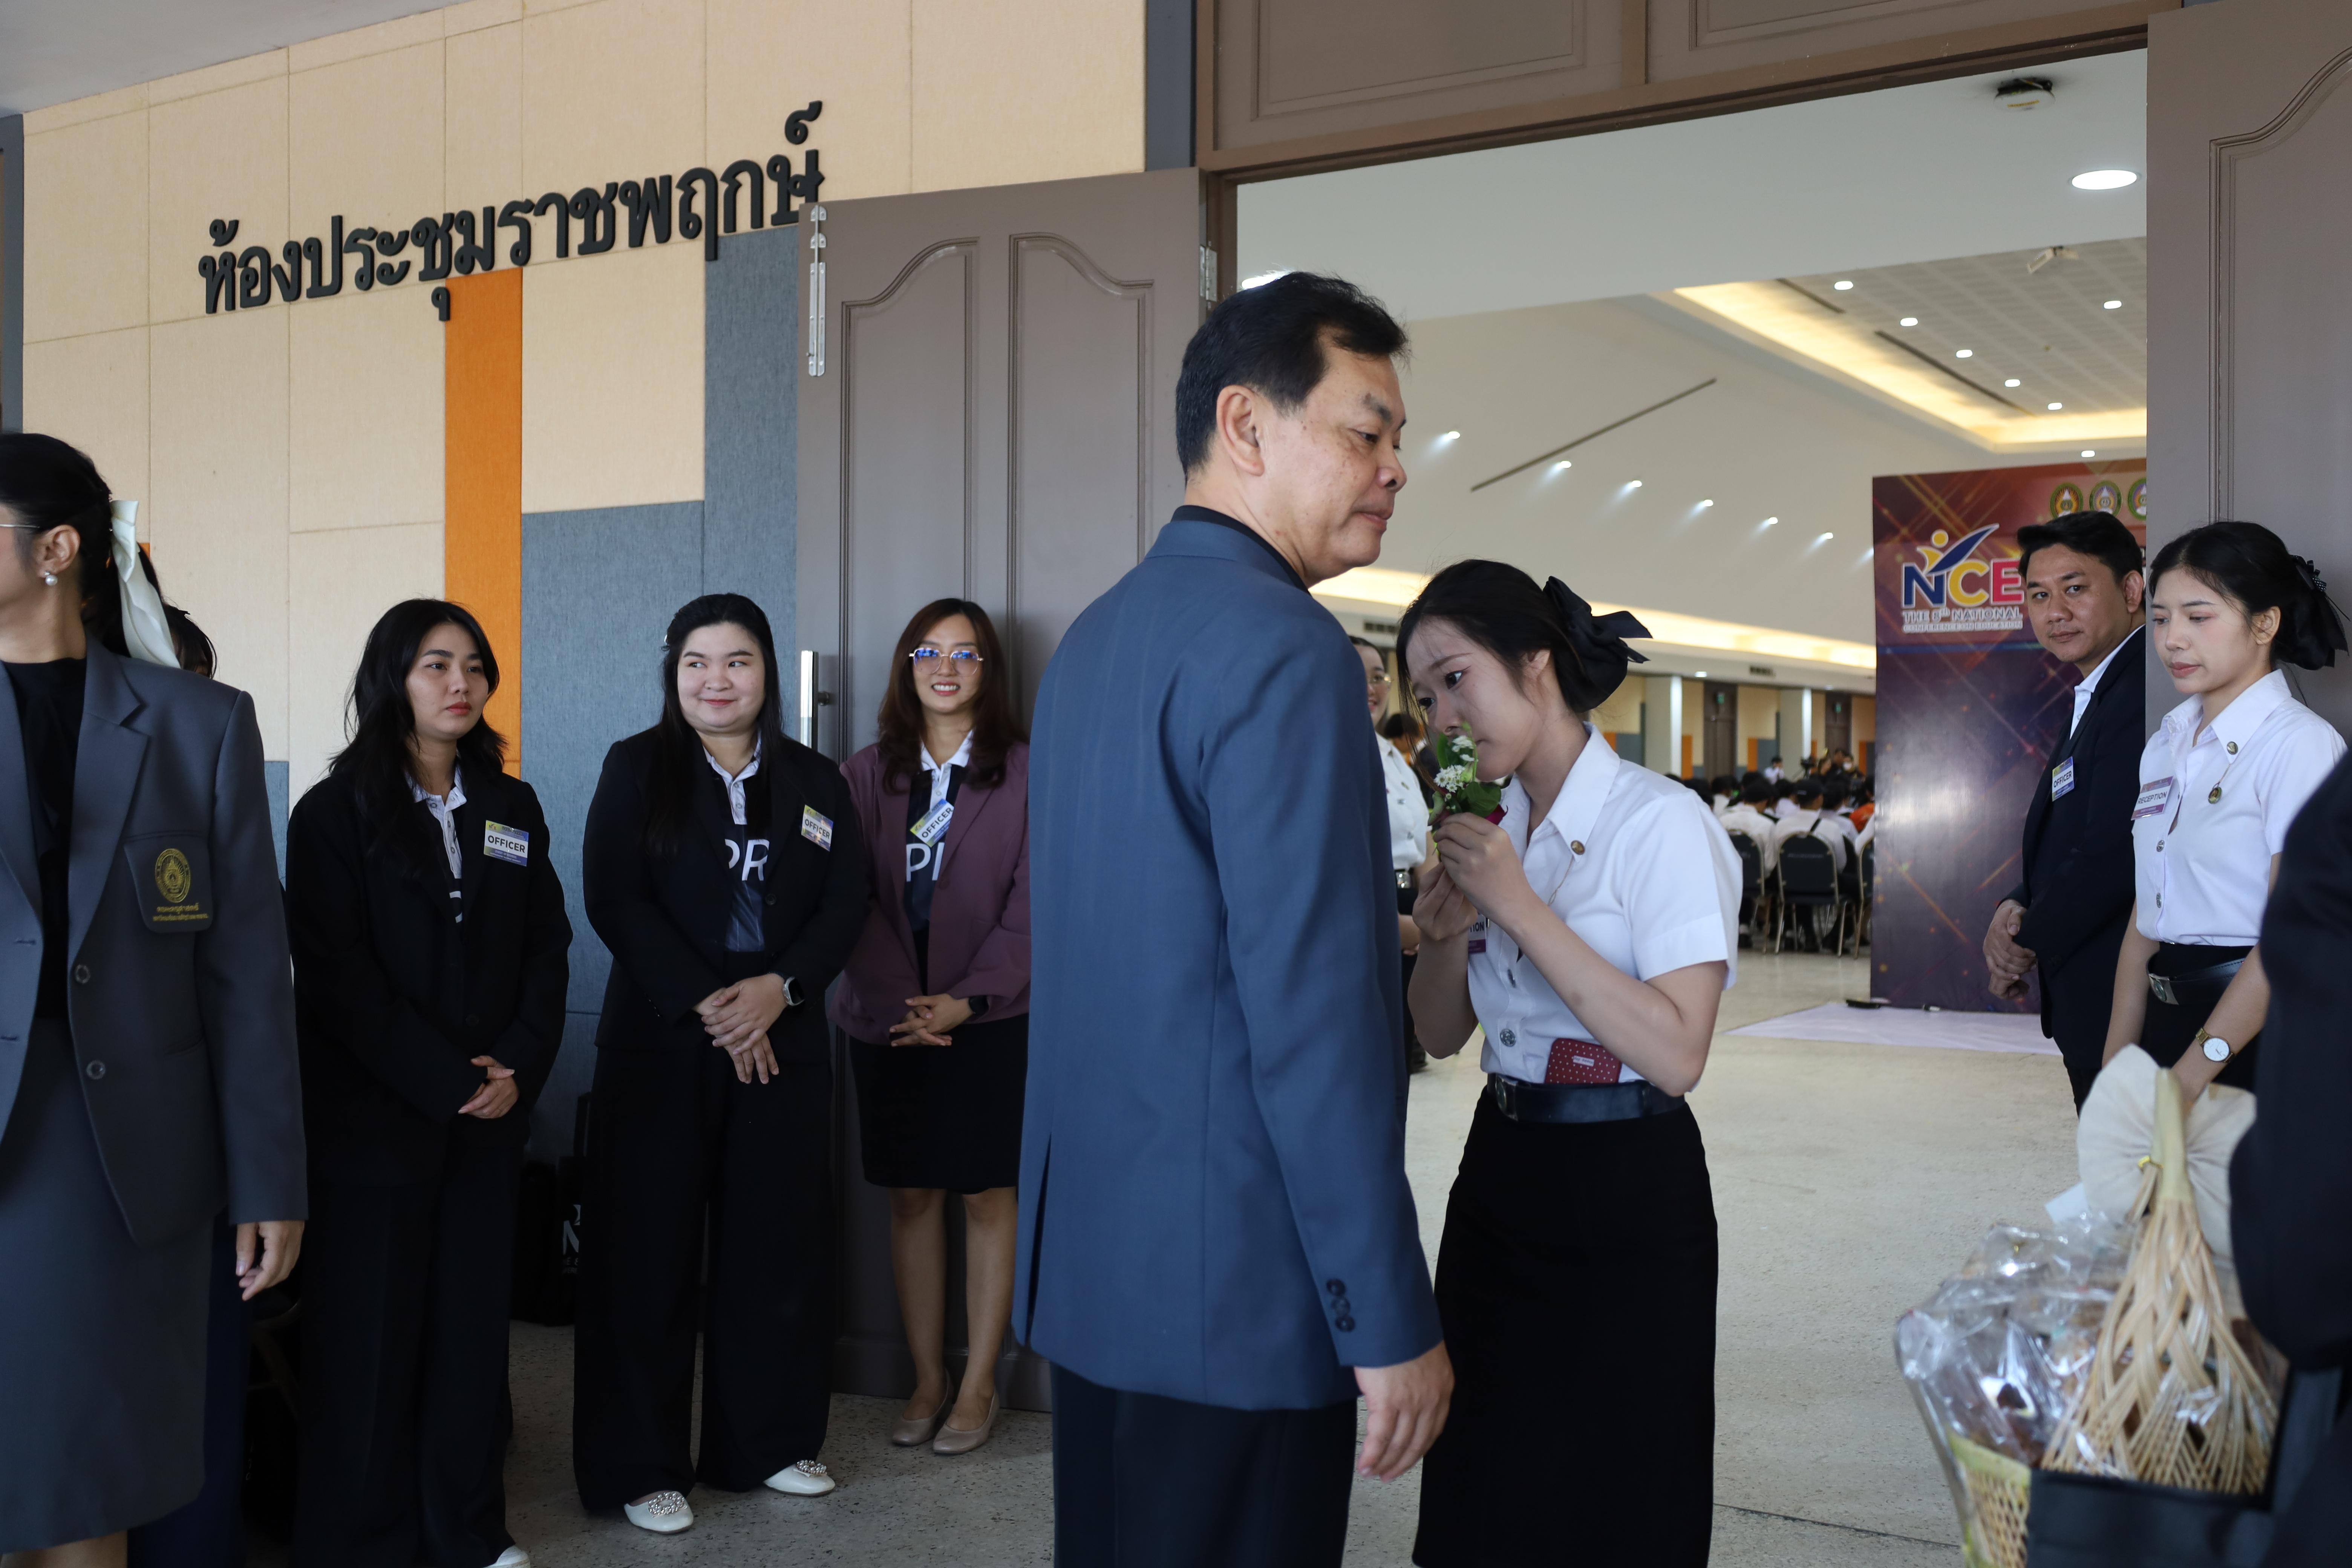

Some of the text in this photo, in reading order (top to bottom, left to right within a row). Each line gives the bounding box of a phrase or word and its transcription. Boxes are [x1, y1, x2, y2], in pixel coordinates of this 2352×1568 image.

[198, 100, 825, 322] ห้องประชุมราชพฤกษ์
[1902, 559, 2024, 608] NCE
[1903, 610, 1930, 623] THE
[1952, 606, 2023, 622] NATIONAL
[2053, 770, 2072, 788] OFFICER
[2137, 791, 2167, 805] RECEPTION
[805, 819, 830, 839] OFFICER
[922, 807, 954, 838] OFFICER
[488, 835, 525, 853] OFFICER
